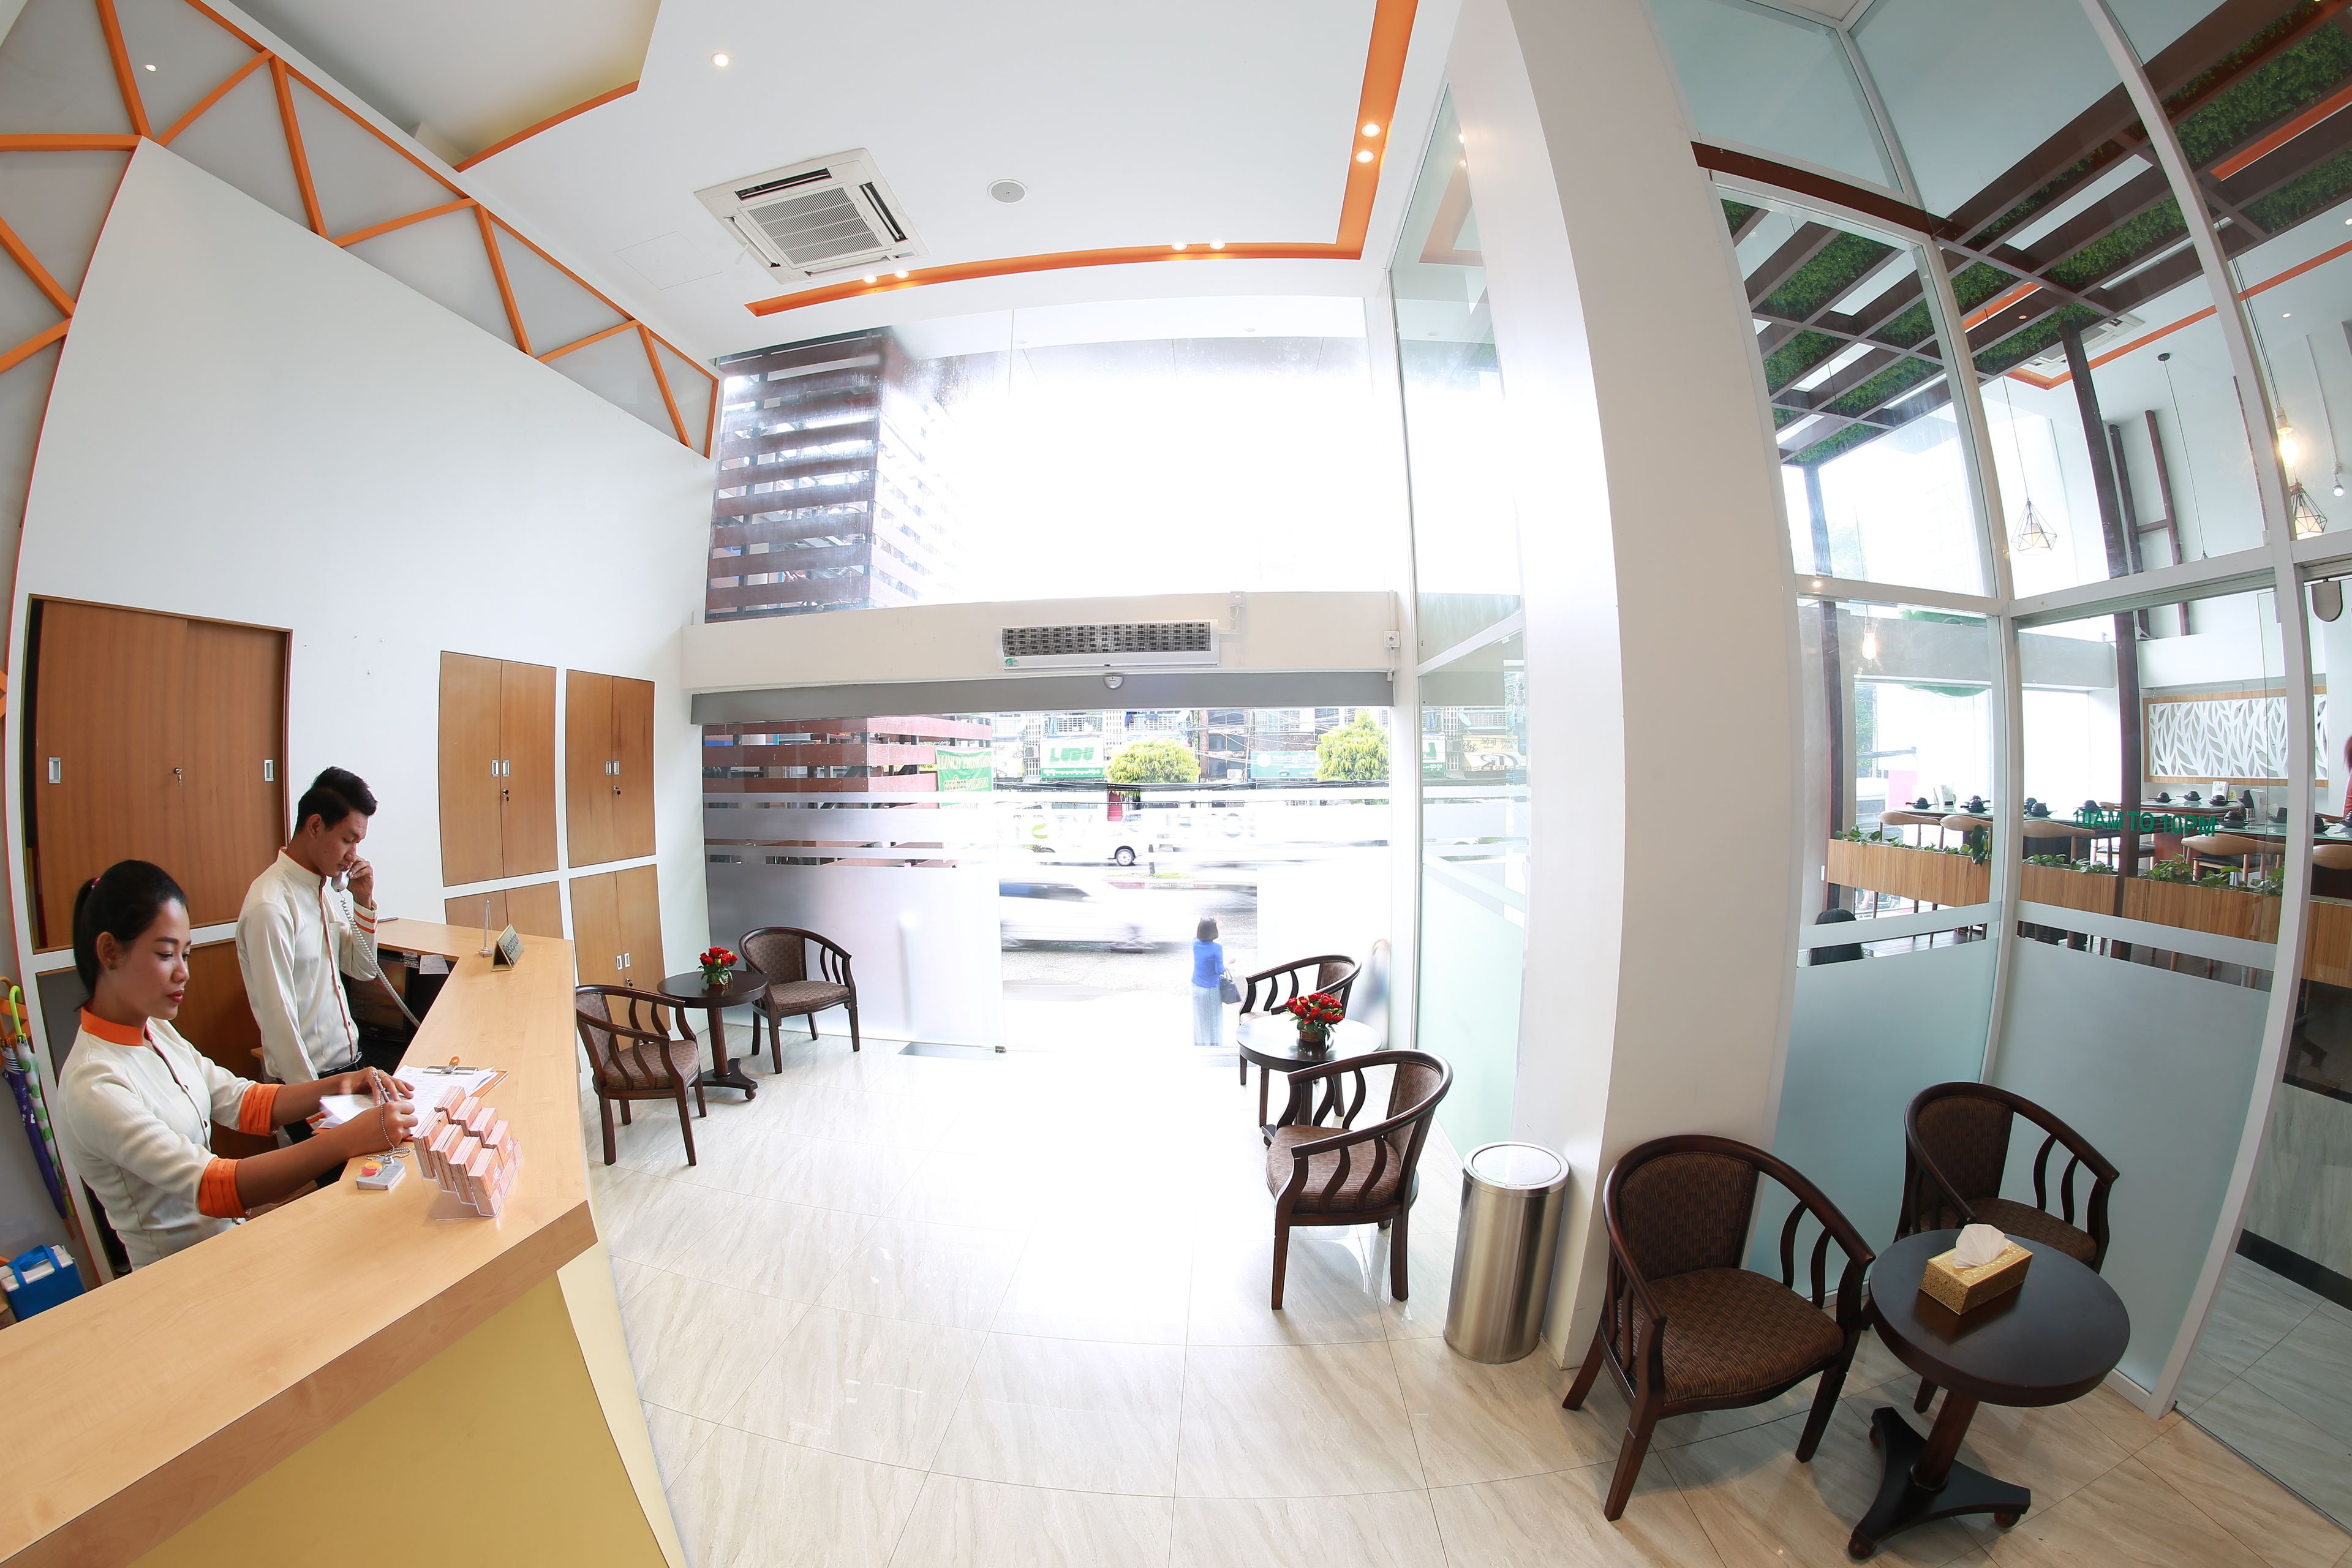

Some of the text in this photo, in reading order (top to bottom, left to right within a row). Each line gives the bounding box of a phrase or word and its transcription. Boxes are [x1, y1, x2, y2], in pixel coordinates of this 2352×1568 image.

[2073, 809, 2216, 837] 10AM TO 10PM
